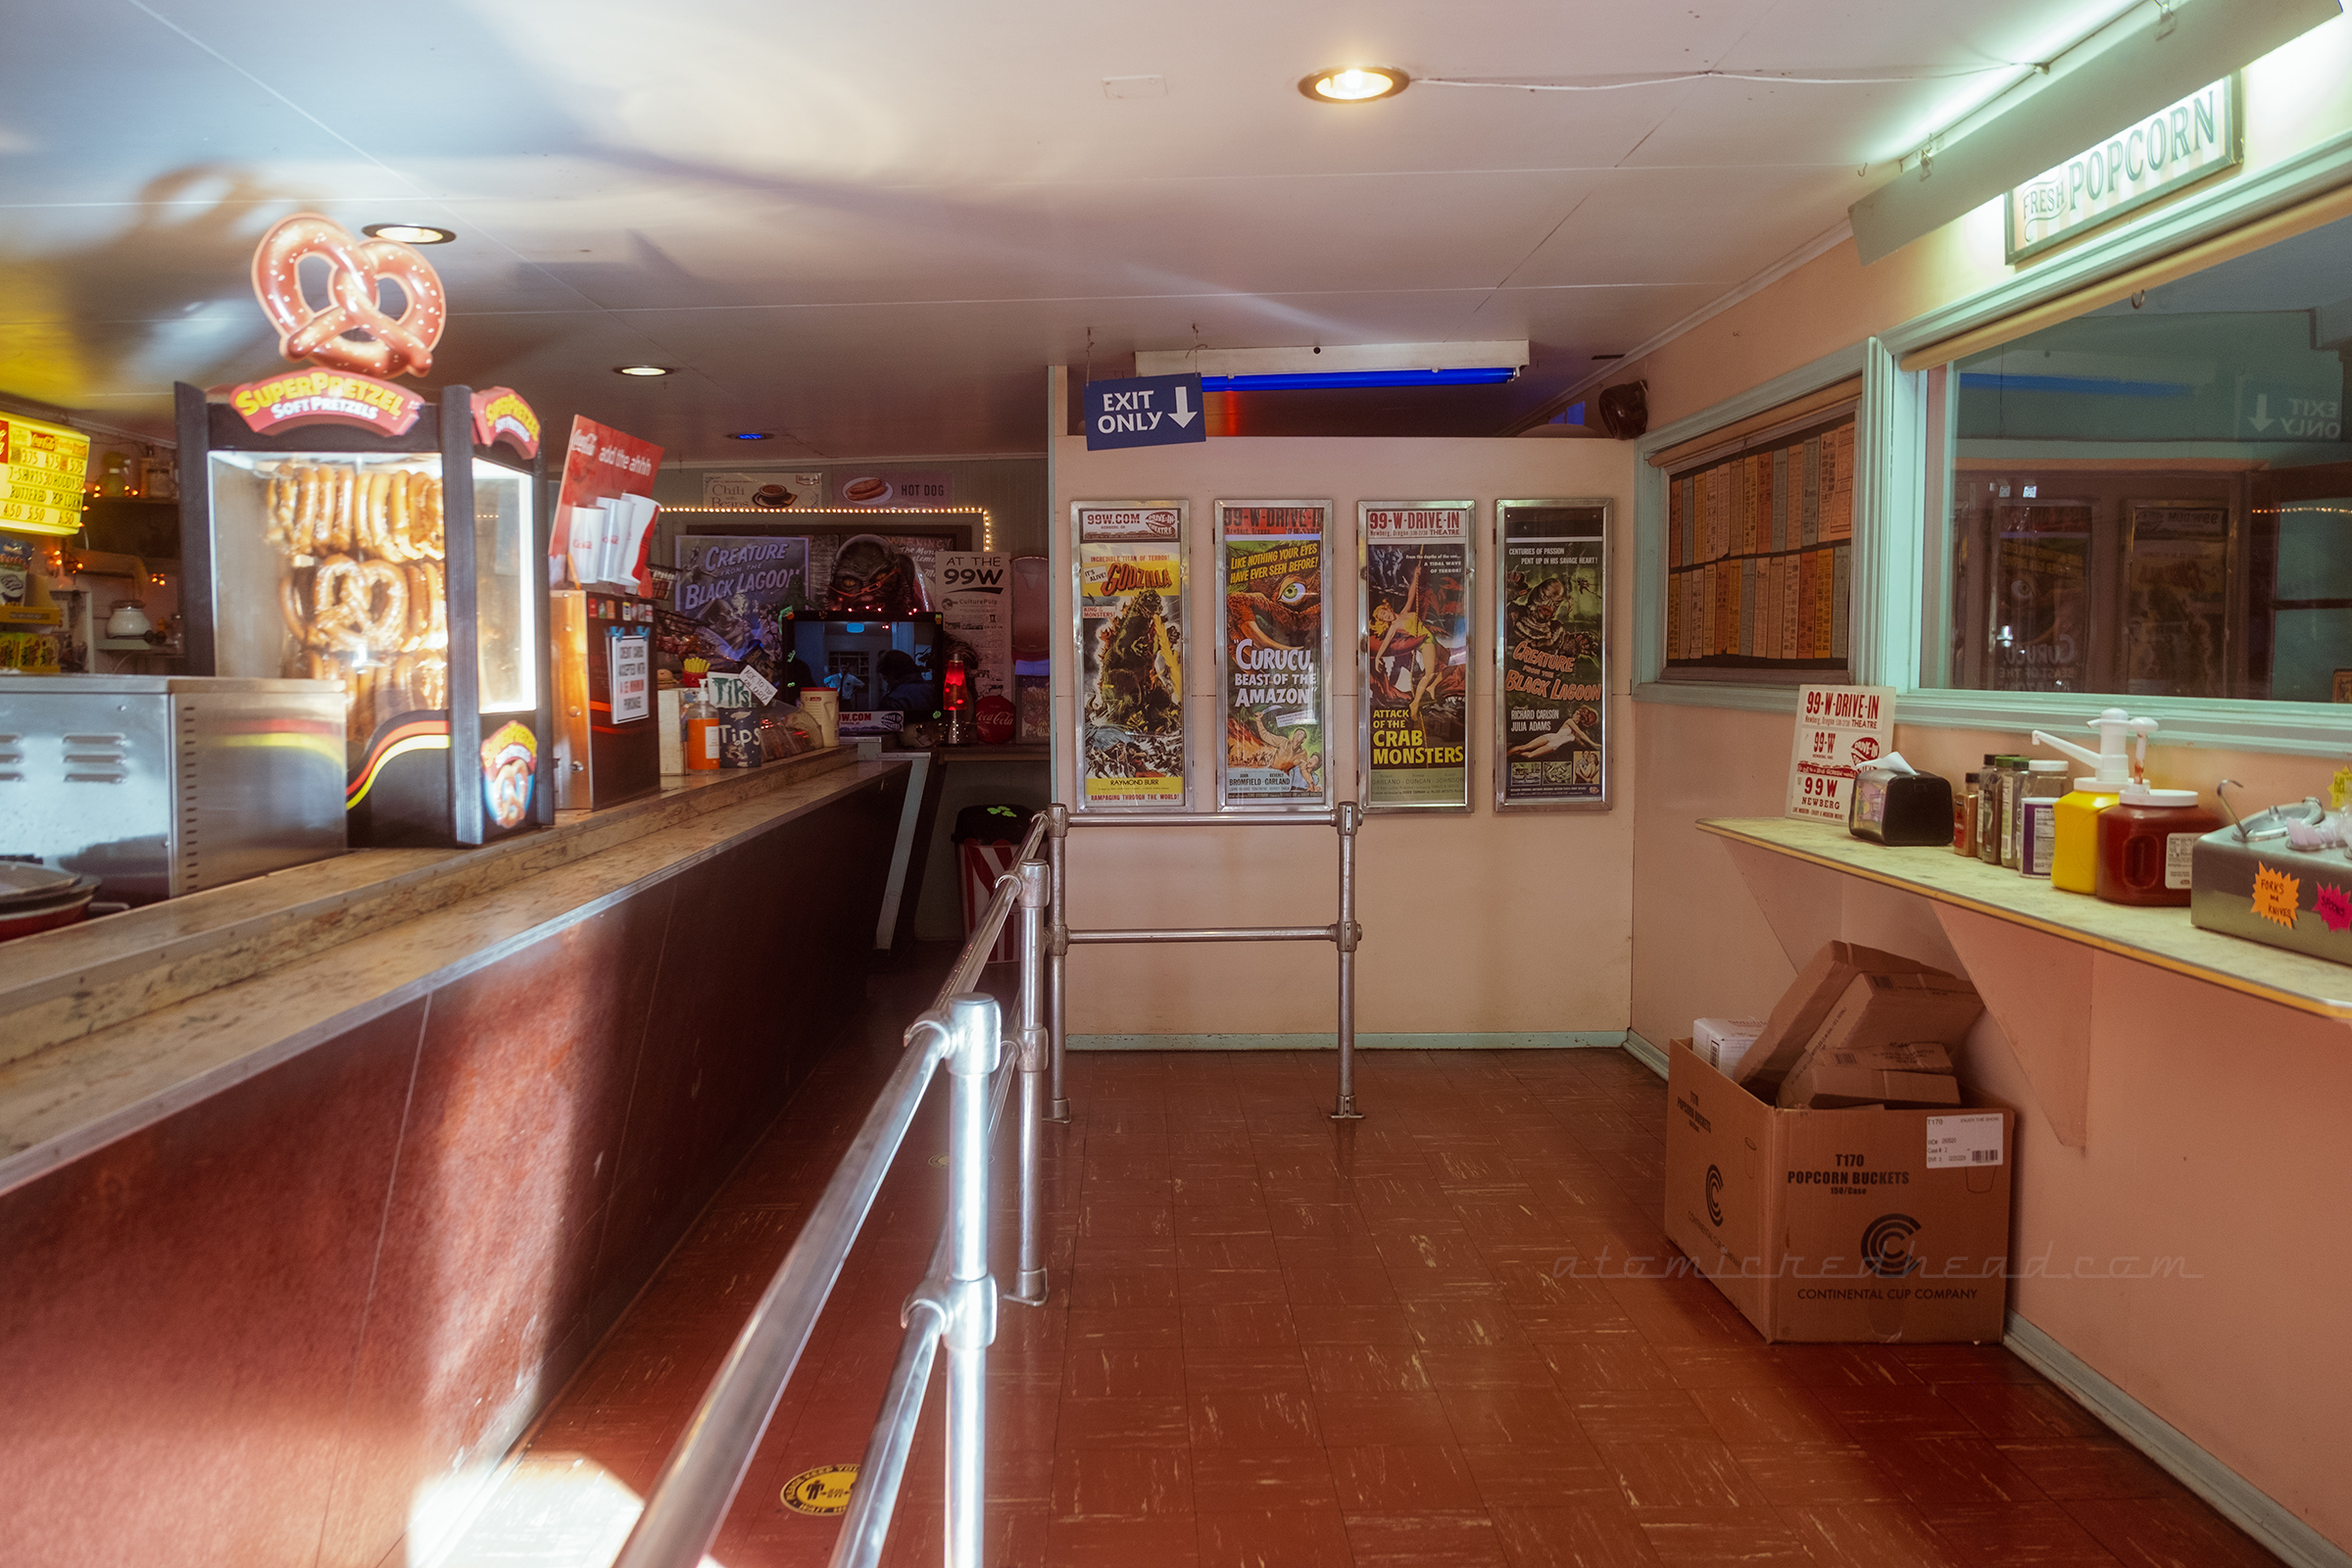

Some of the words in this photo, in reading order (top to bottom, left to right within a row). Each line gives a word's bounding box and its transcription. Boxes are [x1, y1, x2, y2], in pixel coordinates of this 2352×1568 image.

[2024, 178, 2065, 221] FRESH
[2069, 90, 2215, 212] POPCORN
[235, 371, 405, 417] SUPERPRETZEL
[1102, 390, 1154, 413] EXIT
[270, 399, 310, 419] SOFT
[310, 396, 379, 420] PRETZELS
[1098, 412, 1163, 434] ONLY
[599, 445, 616, 466] add
[615, 448, 629, 469] the
[10, 485, 47, 502] BUTTERED
[712, 484, 746, 496] Chili
[902, 484, 920, 496] HOT
[924, 484, 945, 497] DOG
[1087, 514, 1141, 525] 99W.COM
[706, 543, 789, 571] CREATURE
[946, 557, 964, 566] AT
[971, 557, 1001, 566] THE
[1231, 557, 1247, 569] LIKE
[1248, 551, 1278, 565] NOTHING
[1279, 547, 1299, 561] YOUR
[1299, 543, 1317, 556] EYES
[720, 566, 742, 576] FROM
[746, 563, 763, 571] THE
[944, 568, 1004, 585] 99W
[1090, 572, 1107, 582] ALIVE!
[1230, 569, 1249, 584] HAVE
[1250, 567, 1268, 580] EVER
[1269, 564, 1287, 576] SEEN
[1289, 556, 1319, 572] BEFORE!
[1101, 563, 1173, 597] GODZILLA
[685, 578, 735, 611] BLACK
[1513, 641, 1576, 672] CREATURE
[1235, 673, 1270, 686] BEAST
[1273, 673, 1288, 685] OF
[1292, 672, 1317, 685] THE
[1505, 669, 1550, 698] BLACK
[1550, 678, 1601, 702] LAGOON
[1373, 710, 1409, 718] ATTACK
[1511, 710, 1535, 720] RICHARD
[1536, 709, 1559, 720] CARLSON
[1373, 719, 1386, 728] OF
[1387, 719, 1406, 728] THE
[1511, 721, 1527, 732] JULIA
[1529, 721, 1551, 732] ADAMS
[1851, 719, 1877, 729] THEATRE
[1373, 730, 1423, 747] CRAB
[1373, 746, 1464, 764] MONSTERS
[1854, 741, 1879, 759] DRIVE-IN
[1229, 777, 1262, 786] BROMFIELD
[1801, 797, 1840, 810] NEWBERG
[2261, 879, 2284, 895] FORKS
[2268, 904, 2291, 917] KNIVES
[2321, 896, 2345, 916] SPOONS
[1836, 1153, 1864, 1167] T170
[1788, 1171, 1848, 1185] POPCORN
[1852, 1171, 1909, 1185] BUCKETS
[1797, 1289, 1884, 1299] CONTINENTAL
[1886, 1289, 1911, 1299] CUP
[1914, 1288, 1978, 1299] COMPANY
